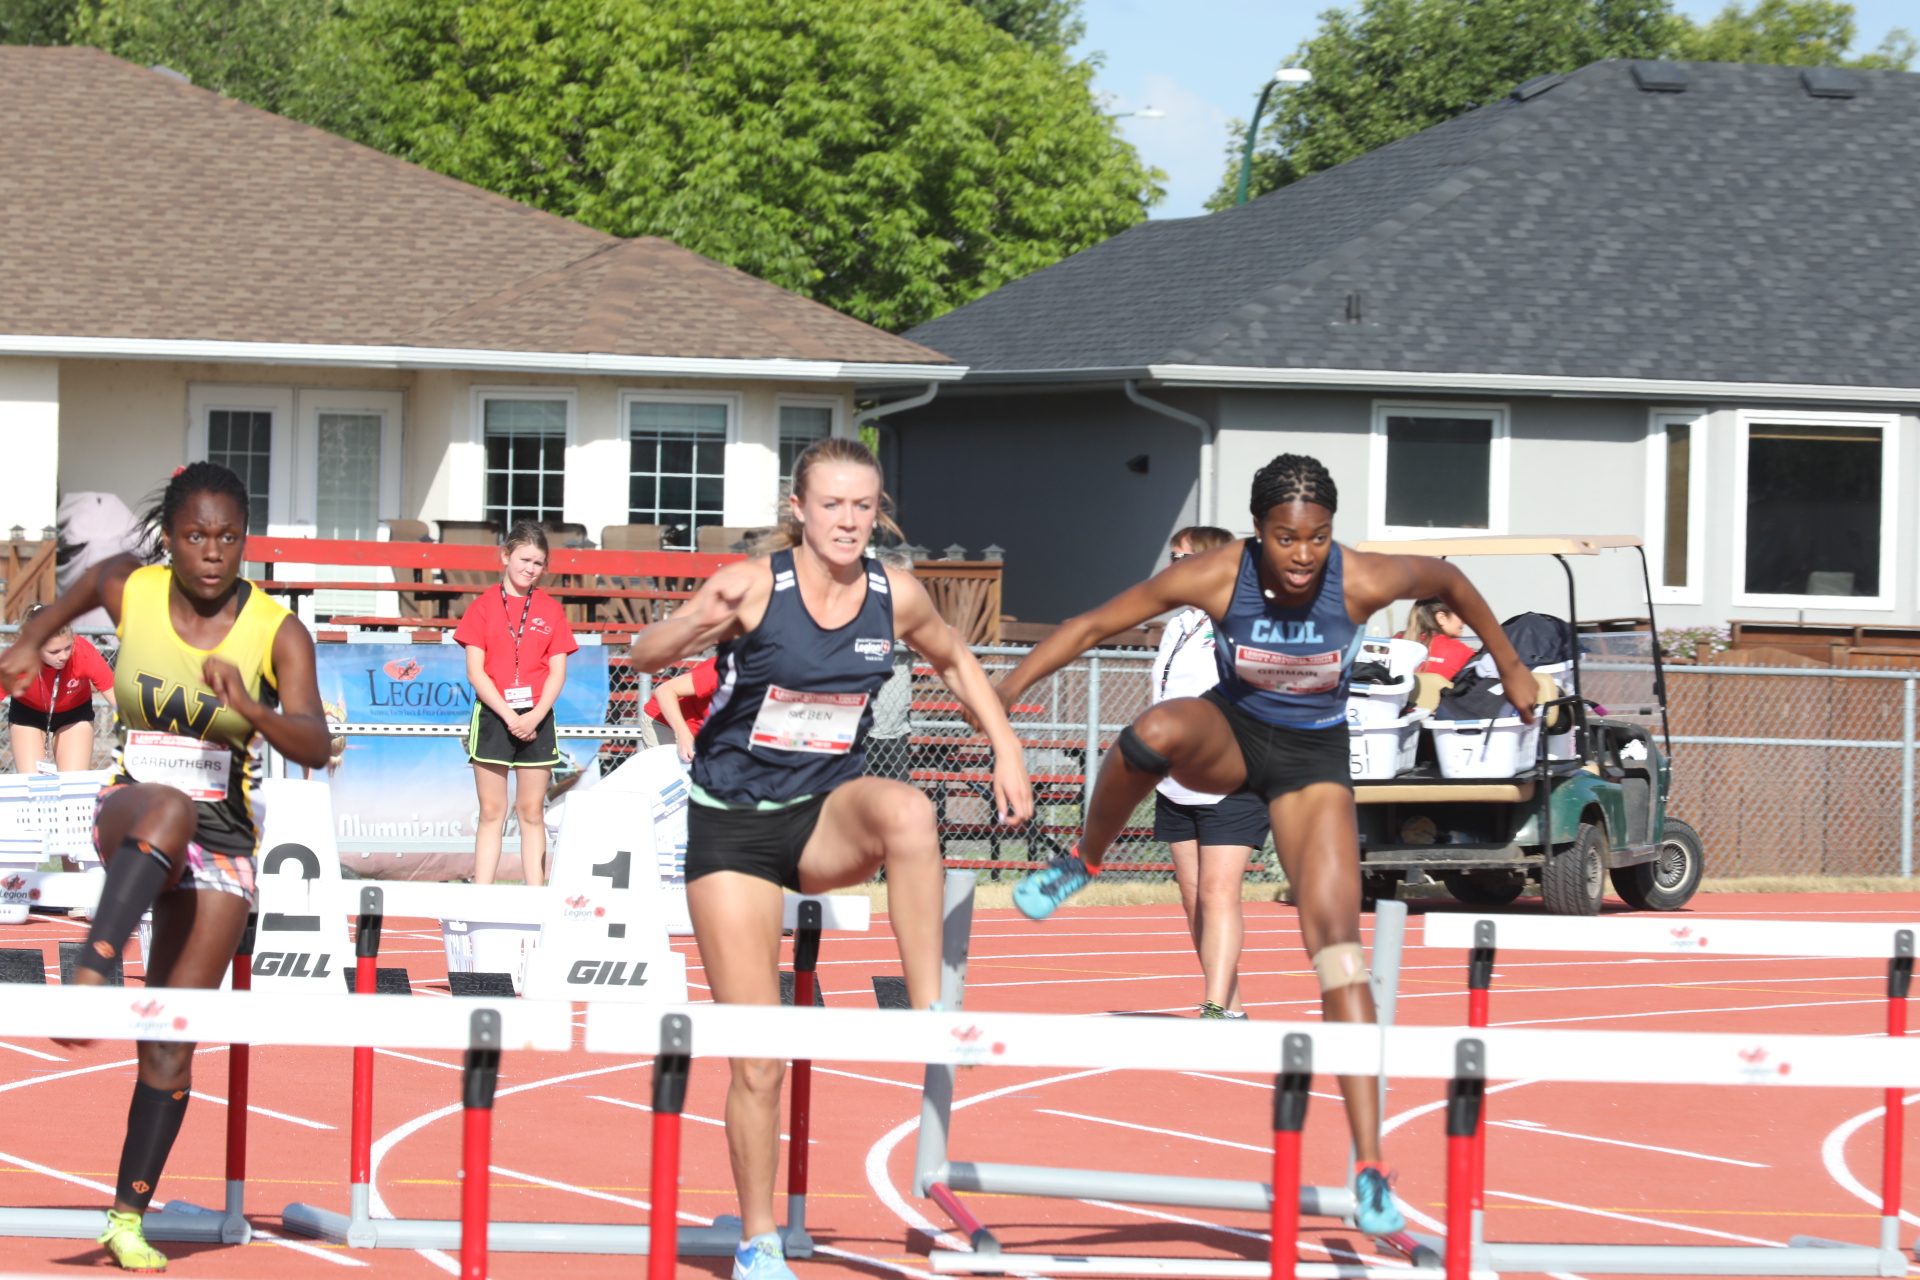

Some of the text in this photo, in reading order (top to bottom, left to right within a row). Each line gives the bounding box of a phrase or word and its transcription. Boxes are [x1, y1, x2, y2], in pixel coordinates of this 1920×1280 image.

[1251, 619, 1324, 643] CADL
[1258, 669, 1318, 677] GERMAIN
[366, 669, 471, 706] LEGION
[133, 671, 227, 740] W
[131, 756, 222, 771] CARRUTHERS
[0, 890, 27, 900] Legion
[564, 909, 592, 918] Legion
[251, 952, 331, 978] GILL
[566, 960, 648, 986] GILL
